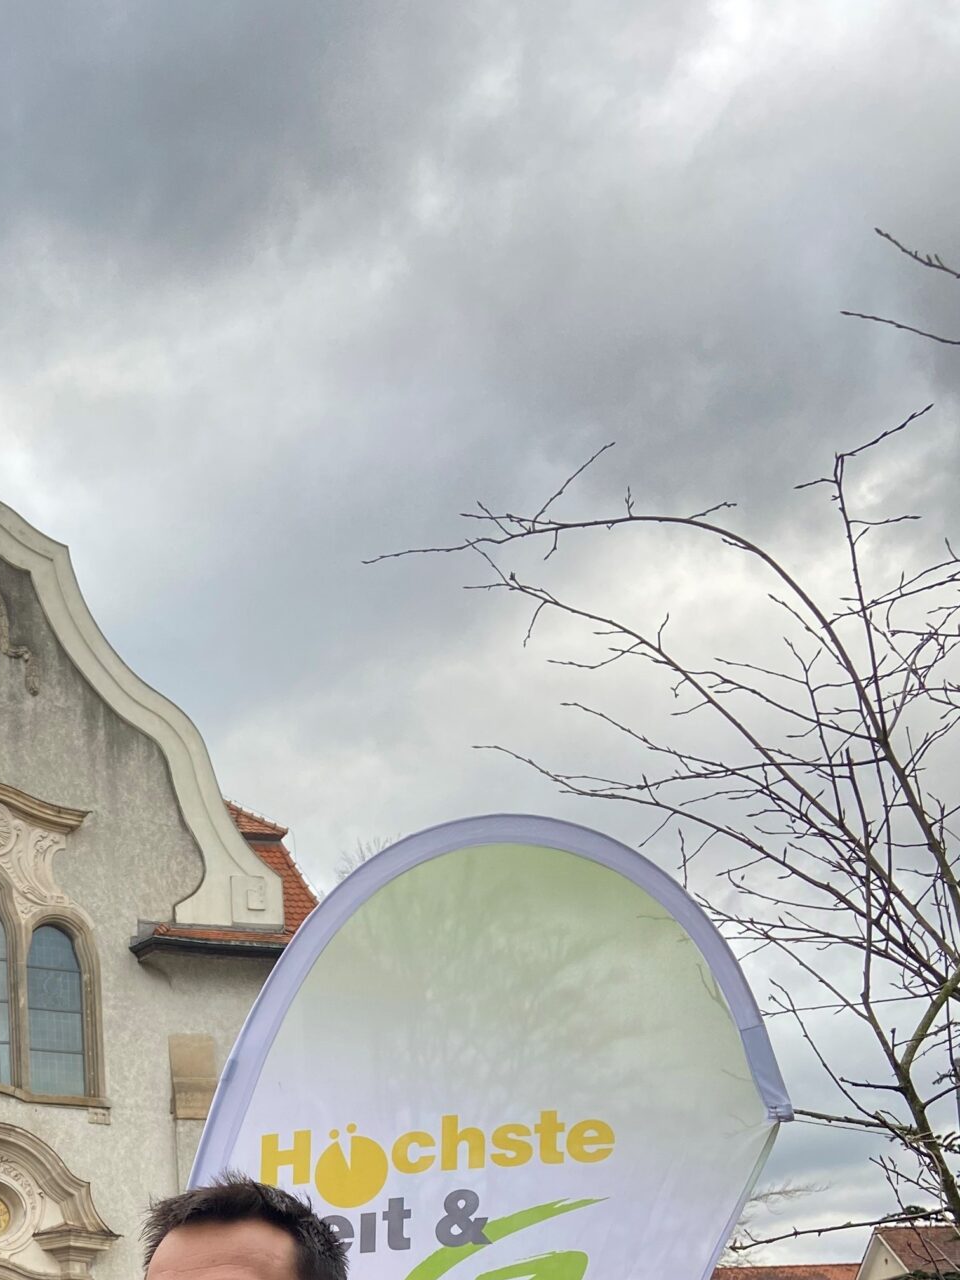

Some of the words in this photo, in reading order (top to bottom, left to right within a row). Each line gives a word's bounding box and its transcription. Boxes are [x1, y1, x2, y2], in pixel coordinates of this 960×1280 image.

[260, 1110, 615, 1209] Höchste
[321, 1197, 411, 1254] eit
[435, 1189, 493, 1247] &
